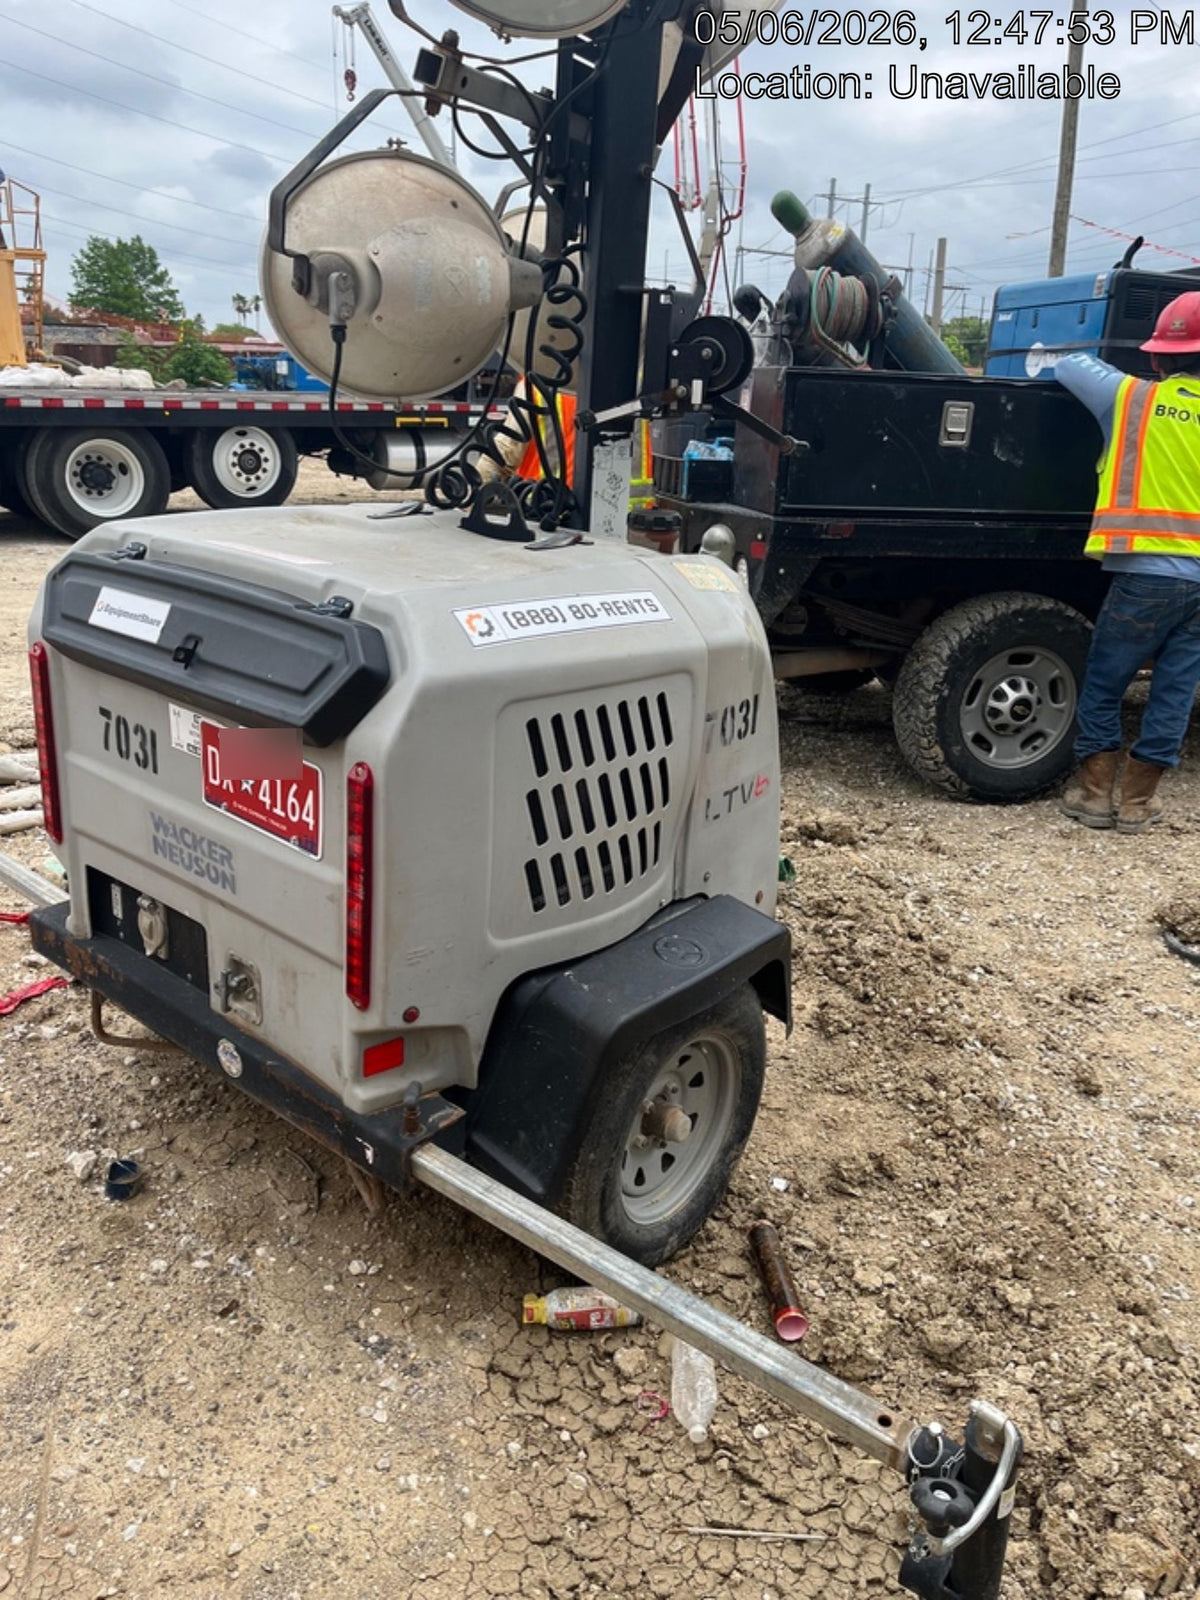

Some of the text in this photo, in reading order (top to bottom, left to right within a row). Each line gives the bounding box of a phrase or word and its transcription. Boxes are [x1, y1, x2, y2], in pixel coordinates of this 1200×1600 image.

[502, 597, 659, 630] (888) 80-RENTS
[98, 706, 158, 775] 7031
[149, 810, 235, 872] WACKER
[152, 834, 236, 895] NEUSON
